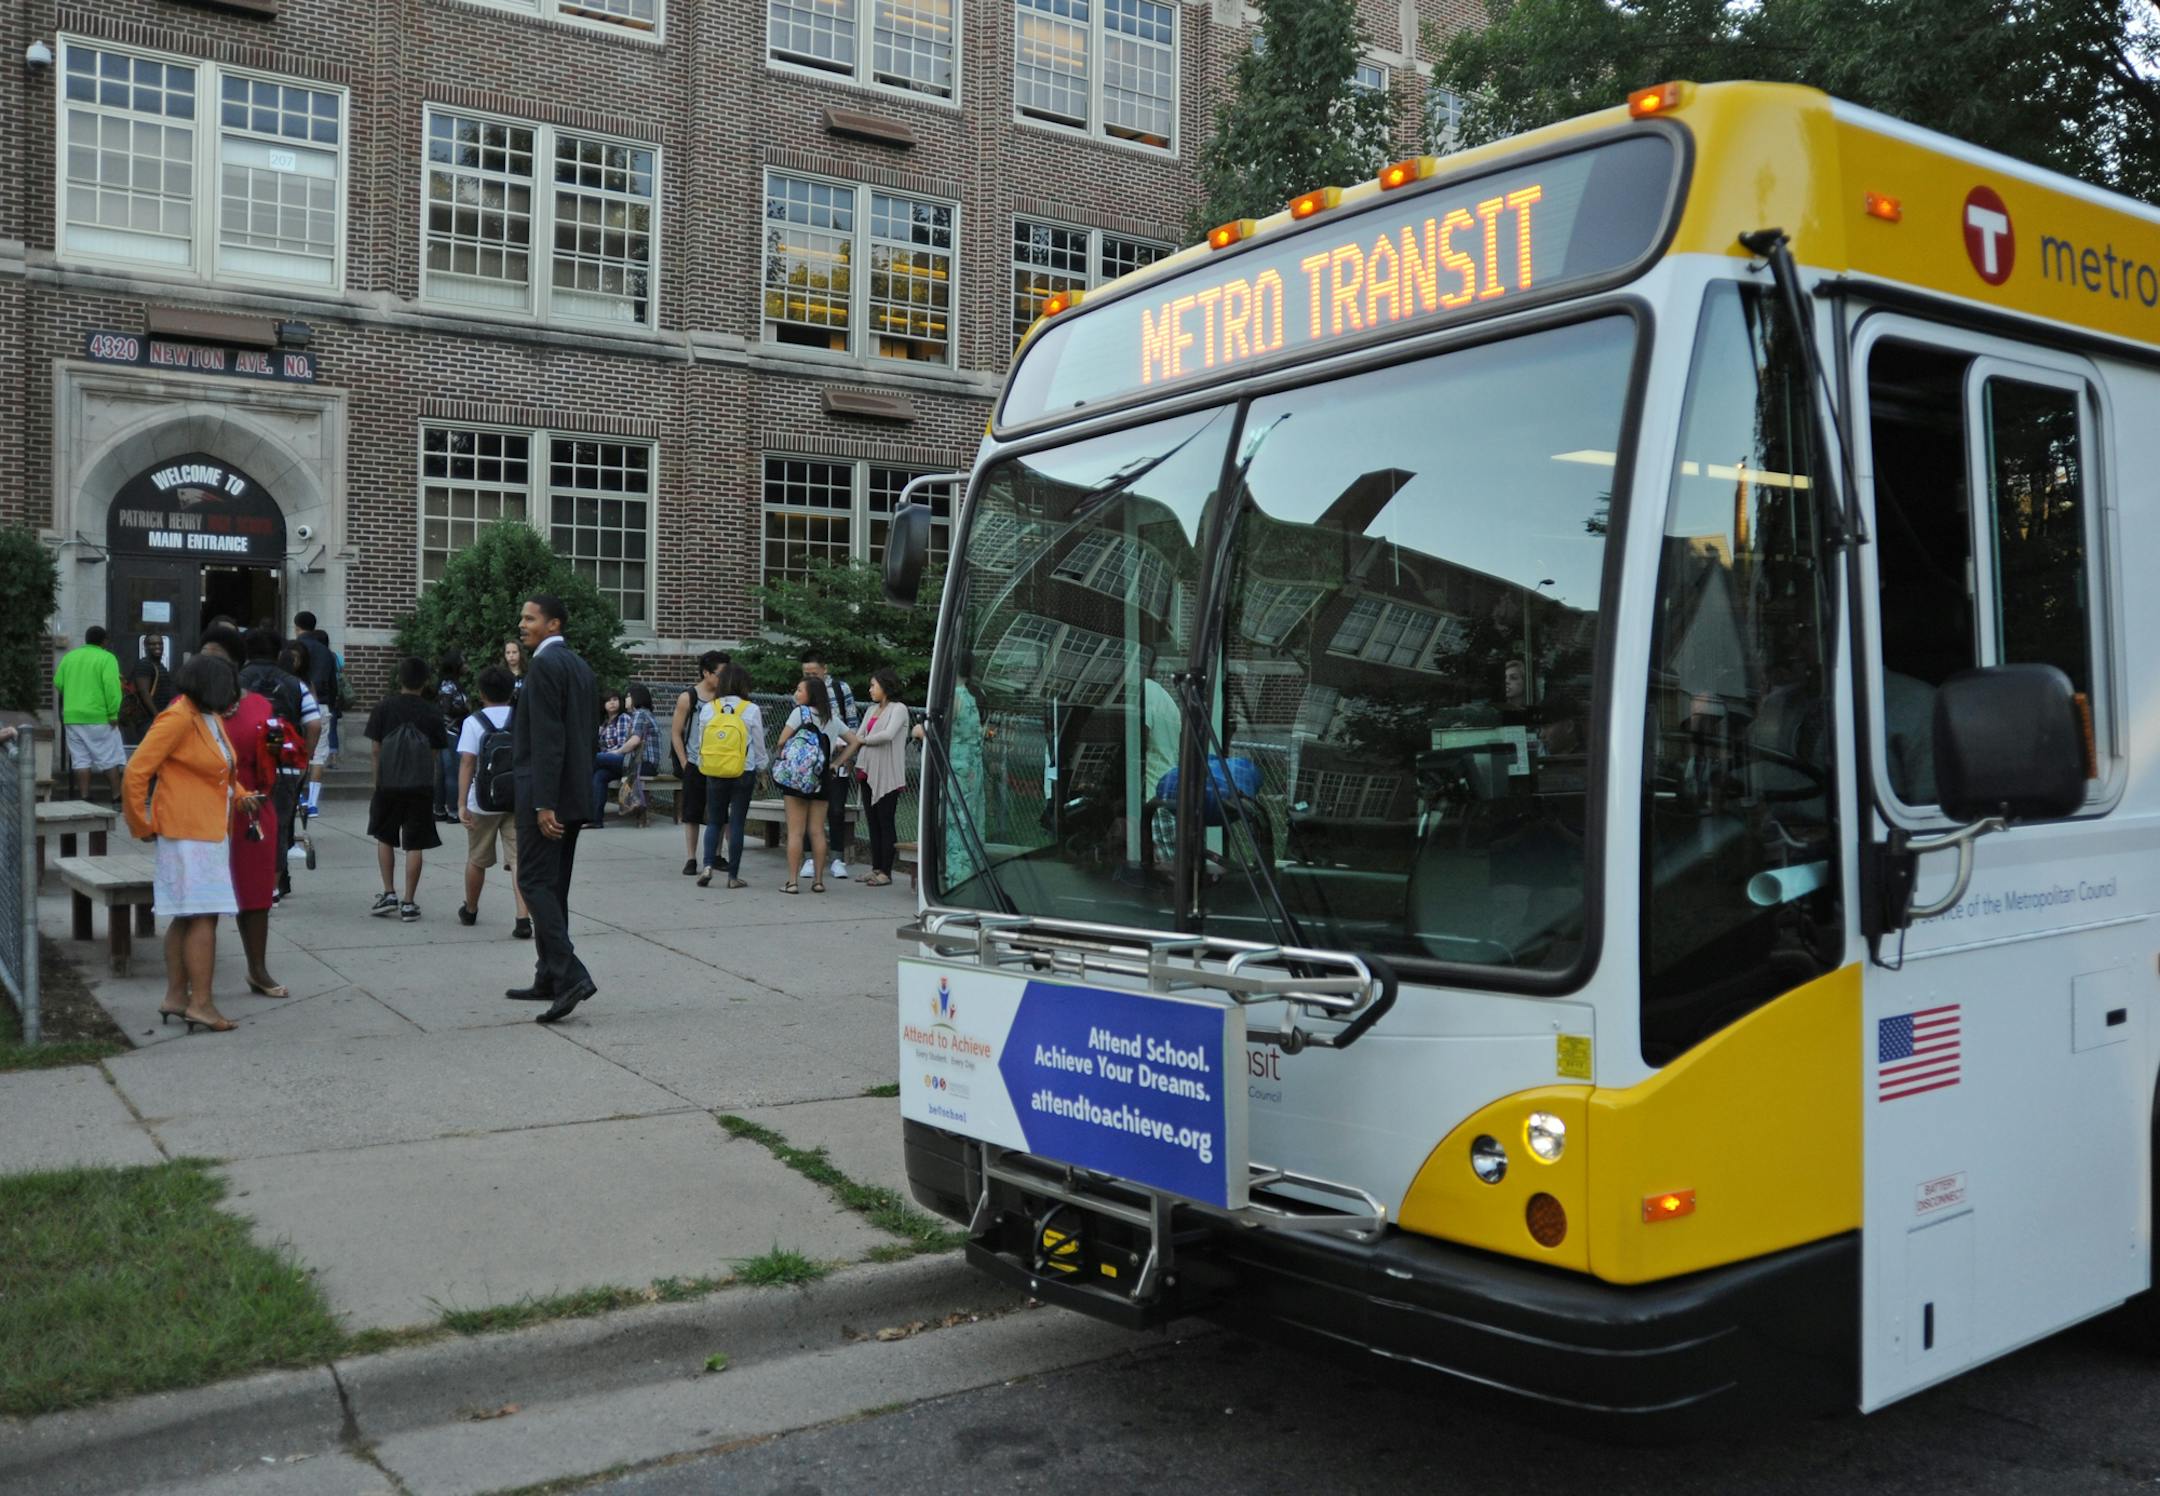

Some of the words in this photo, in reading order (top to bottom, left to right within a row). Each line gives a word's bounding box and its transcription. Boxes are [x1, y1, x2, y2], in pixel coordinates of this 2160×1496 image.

[271, 154, 294, 167] 207
[1967, 204, 2008, 274] T
[1141, 267, 1284, 386] METRO
[1301, 184, 1543, 340] TRANSIT
[2041, 234, 2158, 308] metro
[90, 334, 139, 361] 4320
[150, 341, 225, 370] NEWTON
[235, 350, 273, 375] AVE.
[284, 354, 313, 378] NO.
[151, 464, 223, 491] WELCOME
[225, 474, 245, 496] TO
[119, 509, 164, 529] PATRICK
[168, 511, 203, 531] HENRY
[148, 531, 182, 548] MAIN
[187, 534, 248, 552] ENTRANCE
[1967, 894, 1985, 918] of
[1984, 894, 2001, 914] the
[2004, 884, 2075, 913] Metropolitan
[2077, 876, 2117, 901] Council
[904, 1025, 934, 1047] Attend
[938, 1032, 948, 1050] to
[951, 1034, 991, 1059] Achieve
[1088, 1026, 1142, 1059] Attend
[1146, 1037, 1210, 1073] School.
[1034, 1044, 1093, 1076] Achieve
[1097, 1055, 1134, 1084] Your
[1138, 1063, 1211, 1103] Dreams.
[1248, 1085, 1282, 1104] Council
[1031, 1089, 1213, 1164] attendtoachieve.org
